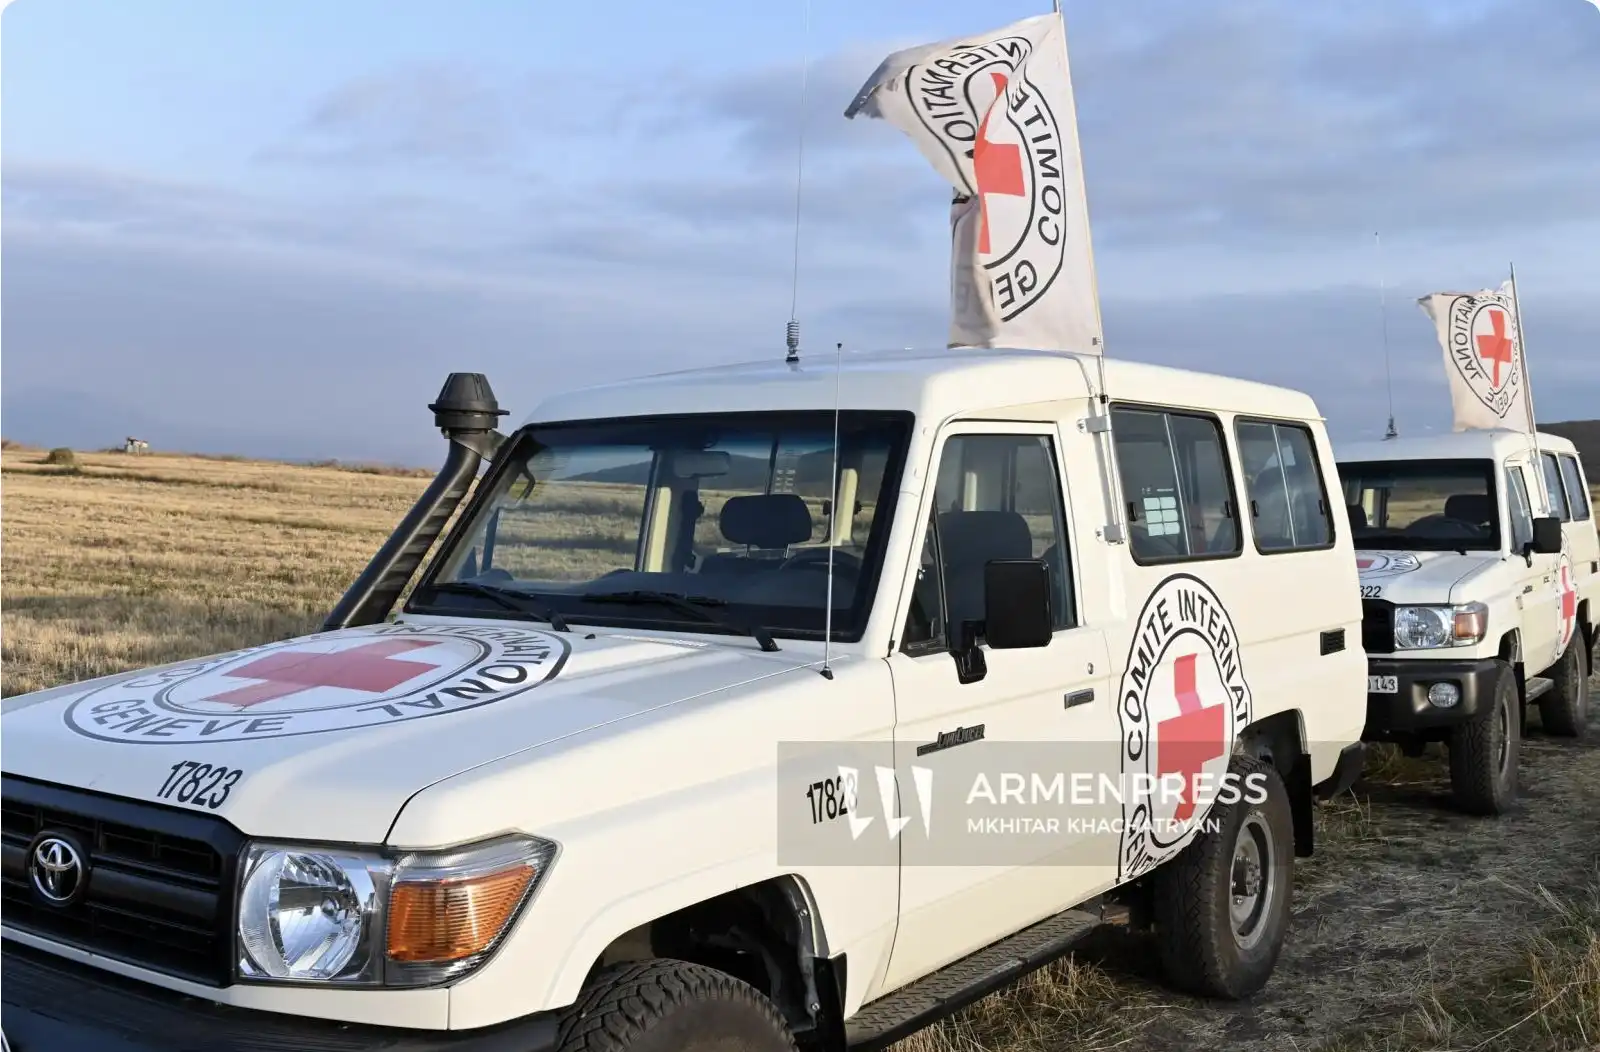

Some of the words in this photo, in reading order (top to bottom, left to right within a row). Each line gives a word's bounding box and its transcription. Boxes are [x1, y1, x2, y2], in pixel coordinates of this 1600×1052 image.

[356, 626, 551, 717] INTERNATIONAL
[1124, 598, 1173, 762] COMITE
[91, 699, 293, 737] GENEVE
[156, 760, 243, 809] 17823
